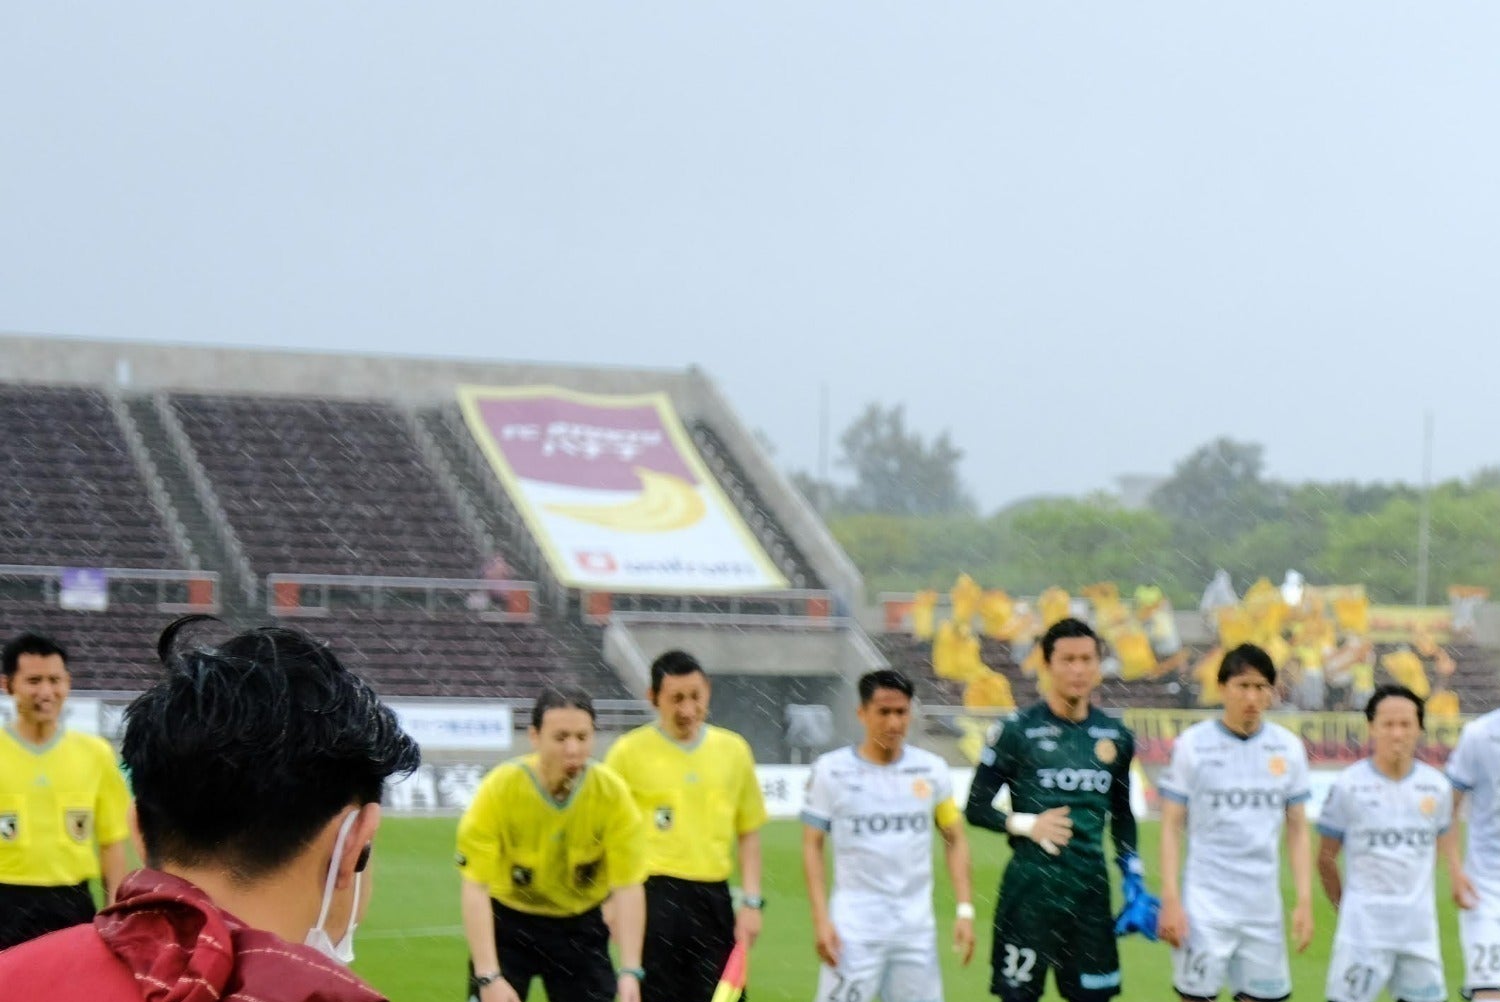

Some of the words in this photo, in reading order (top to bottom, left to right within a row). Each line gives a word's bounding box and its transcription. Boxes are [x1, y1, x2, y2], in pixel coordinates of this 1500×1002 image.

[1036, 767, 1113, 794] TOTO
[852, 812, 929, 834] TOTO
[1000, 943, 1037, 981] 32
